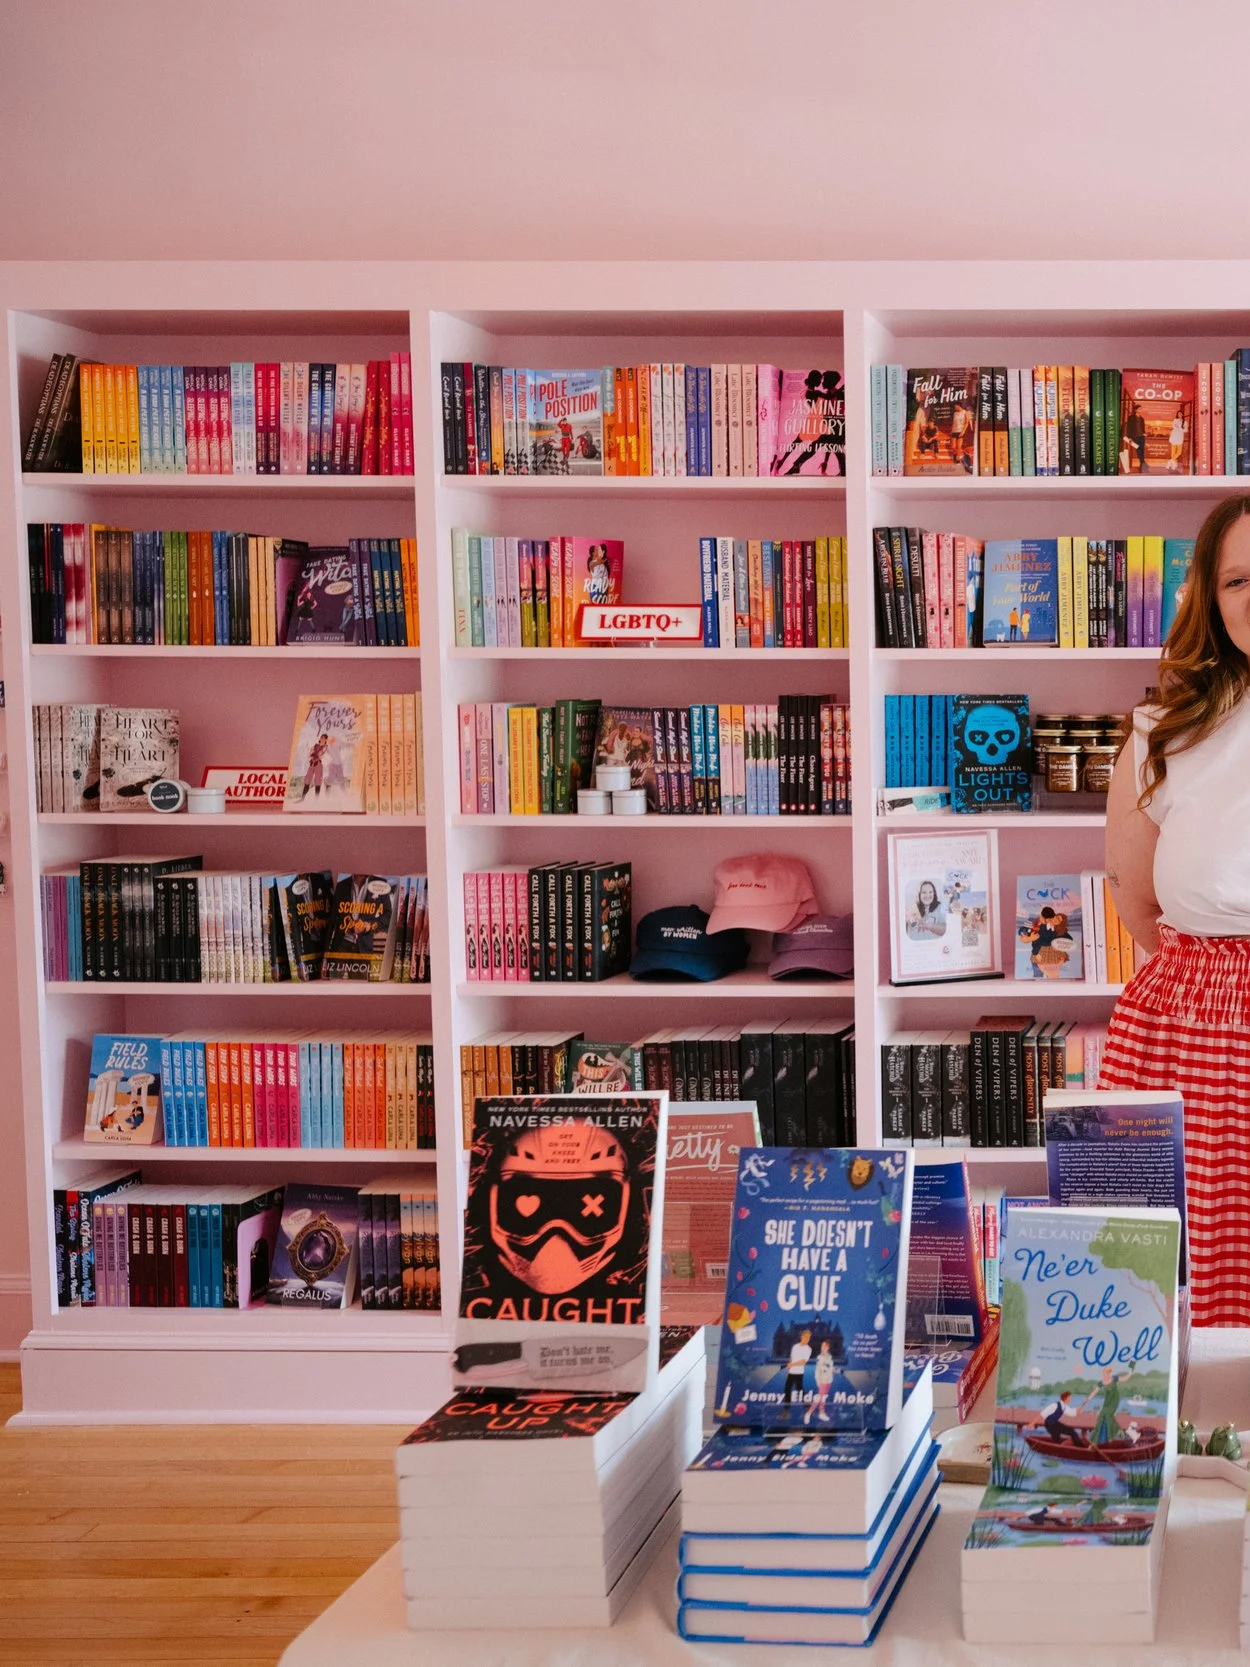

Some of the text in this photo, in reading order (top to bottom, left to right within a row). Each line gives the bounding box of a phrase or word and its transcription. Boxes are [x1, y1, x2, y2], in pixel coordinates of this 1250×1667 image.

[539, 379, 567, 402] POLE
[913, 375, 942, 393] Fall
[924, 389, 969, 408] for Him
[1135, 389, 1183, 401] CO-OP
[545, 392, 598, 419] POSITION
[789, 399, 844, 416] JASMINE
[784, 418, 846, 436] GUILLORY
[1004, 553, 1038, 561] ABBY
[992, 562, 1051, 572] JIMENEZ
[583, 578, 615, 592] READY
[703, 572, 712, 601] MATERIAL
[1028, 581, 1041, 592] of
[1018, 592, 1051, 604] World
[599, 614, 681, 629] LGBTQ+
[306, 702, 362, 722] Forever
[317, 717, 356, 737] Yours
[238, 773, 286, 784] LOCAL
[959, 773, 1028, 786] LIGHTS
[225, 786, 286, 797] AUTHOR
[975, 789, 1011, 801] OUT
[111, 1042, 148, 1056] FIELD
[974, 1037, 982, 1056] DEN
[105, 1055, 147, 1069] RULES
[975, 1070, 983, 1100] VIPERS
[490, 1116, 643, 1127] NAVESSA ALLEN
[1136, 1117, 1156, 1126] night
[1158, 1116, 1173, 1124] will
[1142, 1128, 1173, 1136] enough.
[765, 1220, 873, 1246] SHE DOESN'T
[1017, 1228, 1167, 1245] ALEXANDRA VASTI
[781, 1248, 848, 1271] HAVE A
[1014, 1248, 1098, 1281] Ne'er
[282, 1288, 332, 1301] REGALUS
[777, 1275, 841, 1312] CLUE
[466, 1298, 642, 1324] CAUGHT
[1046, 1284, 1131, 1325] Duke
[1072, 1325, 1163, 1367] Well
[741, 1390, 875, 1405] Jenny Elder Moke
[444, 1402, 628, 1415] CAUGHT
[486, 1417, 550, 1430] UP
